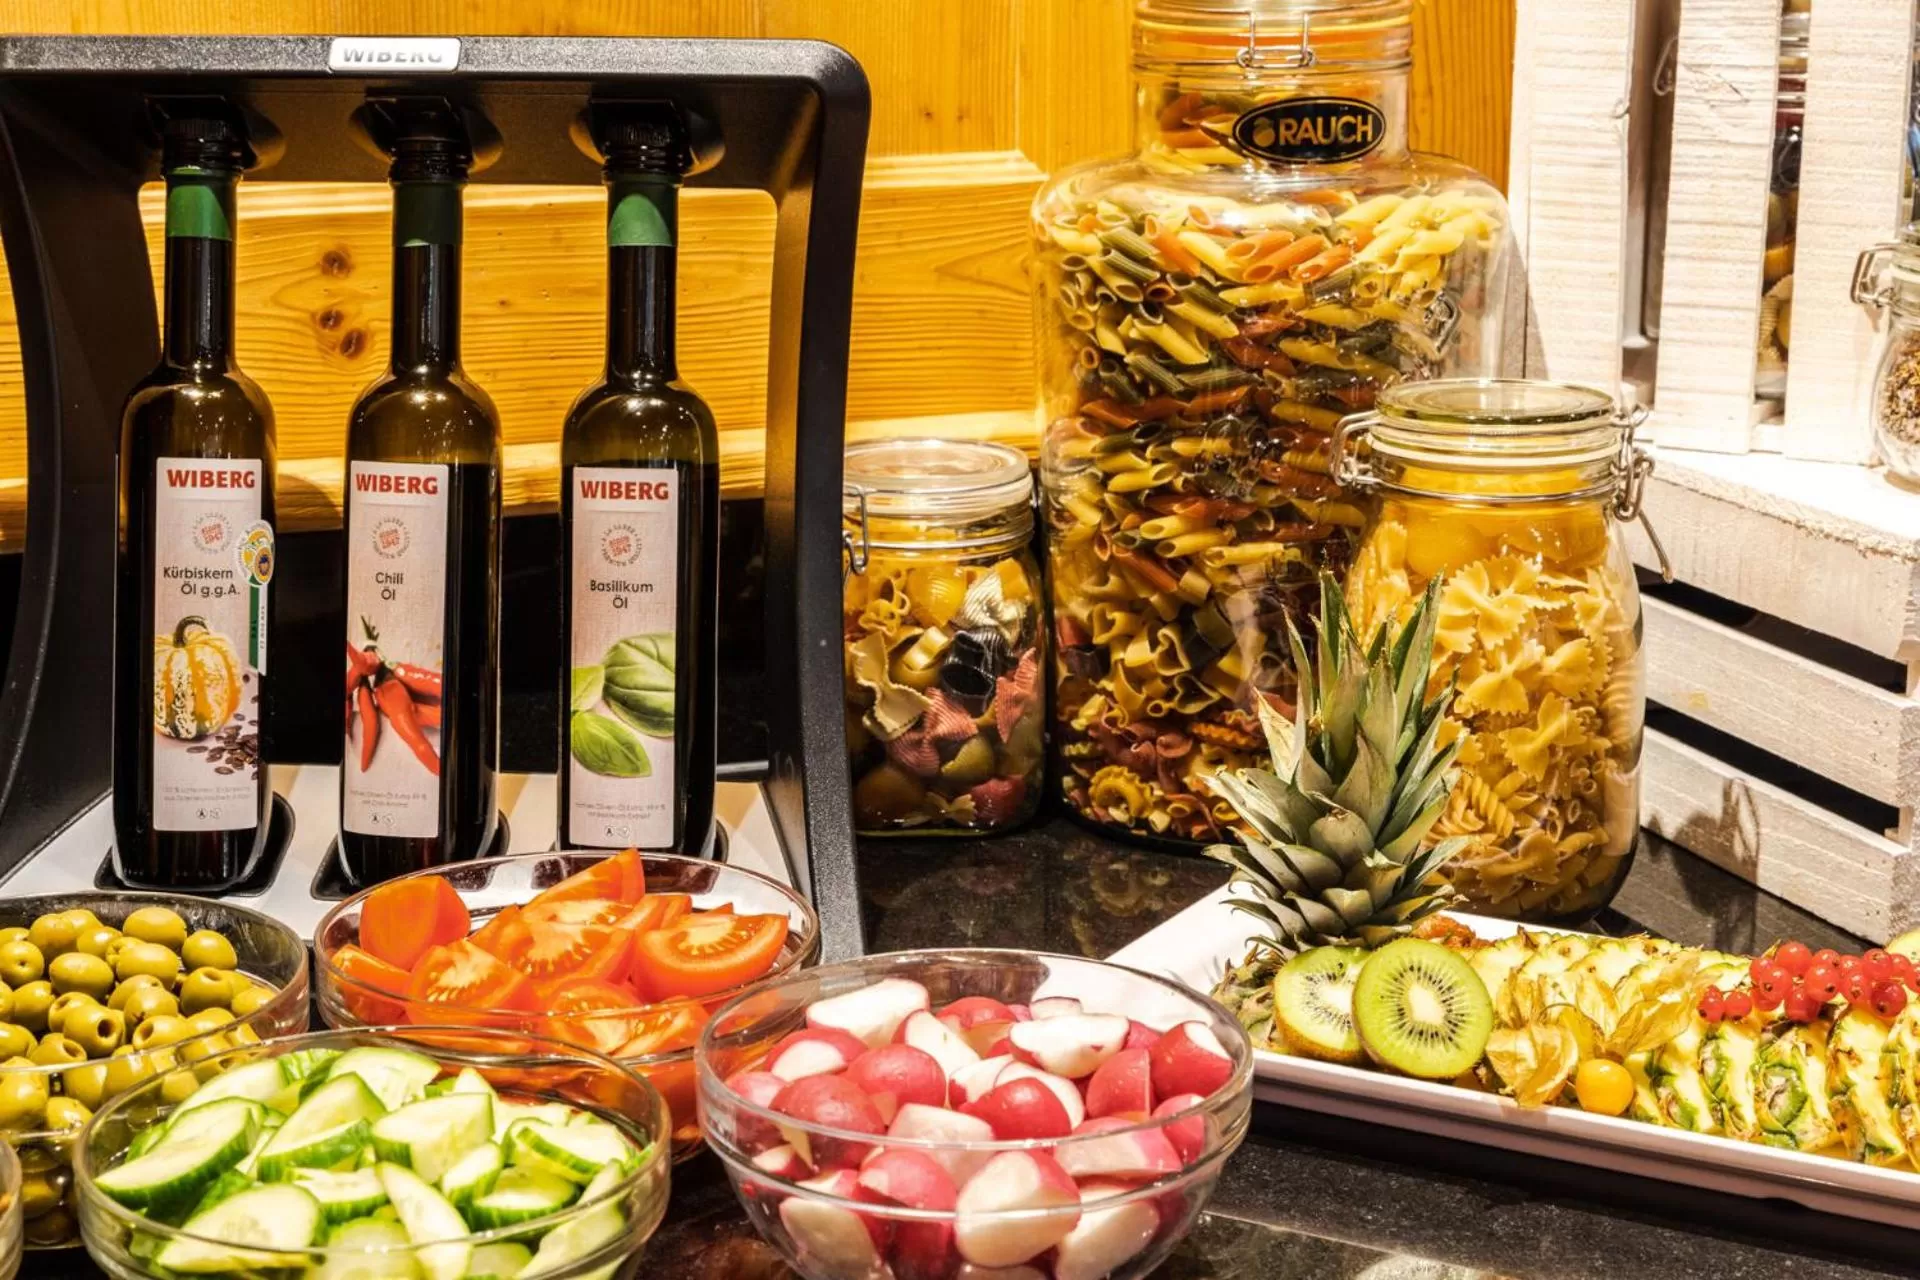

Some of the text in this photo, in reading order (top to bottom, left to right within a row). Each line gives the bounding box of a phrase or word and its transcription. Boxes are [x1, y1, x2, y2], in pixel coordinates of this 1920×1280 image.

[1278, 114, 1373, 146] RAUCH
[166, 469, 255, 488] WIBERG
[355, 473, 438, 495] WIBERG
[580, 480, 669, 500] WIBERG
[163, 565, 233, 580] Kürbiskern
[375, 571, 403, 585] Chili
[180, 581, 197, 596] Öl
[380, 585, 396, 601] Öl
[589, 579, 654, 593] Basilikum
[612, 595, 628, 609] Öl
